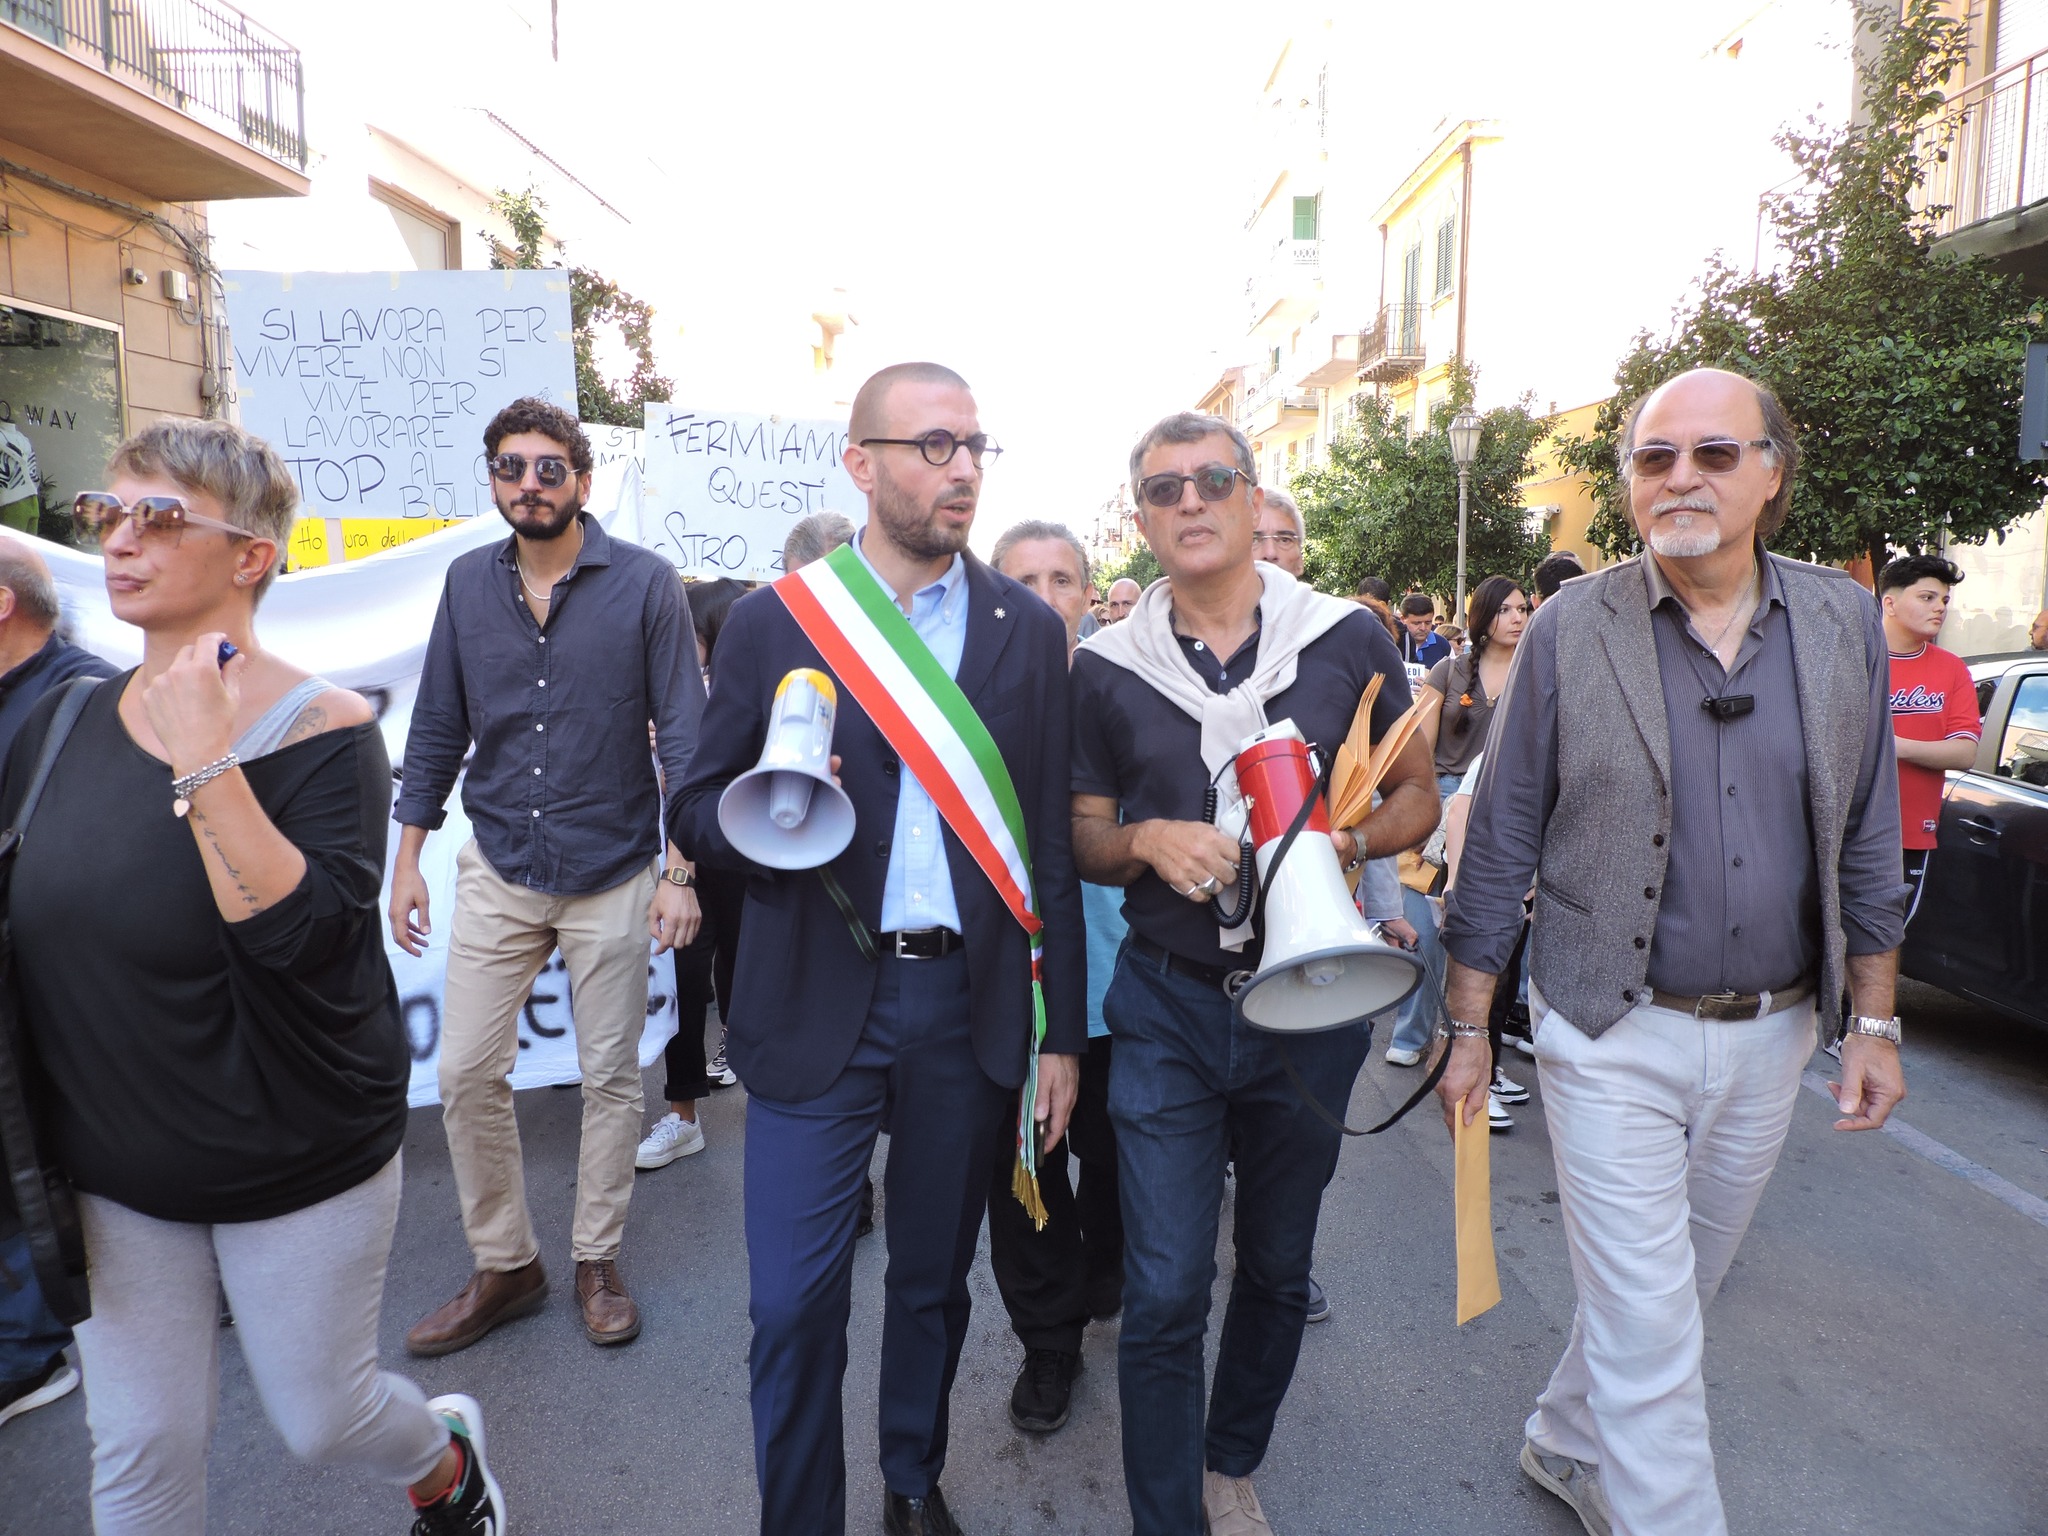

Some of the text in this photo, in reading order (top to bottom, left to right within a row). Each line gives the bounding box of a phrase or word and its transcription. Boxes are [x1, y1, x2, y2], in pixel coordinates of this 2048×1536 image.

[260, 306, 547, 343] SI LAVORA PER
[382, 346, 446, 379] NON
[477, 347, 507, 378] SI
[299, 381, 477, 415] VIVE PER
[24, 404, 77, 430] WAY
[283, 415, 454, 448] LAVORARE
[283, 454, 386, 504] TOP
[410, 451, 454, 486] AL
[1890, 684, 1945, 708] kless
